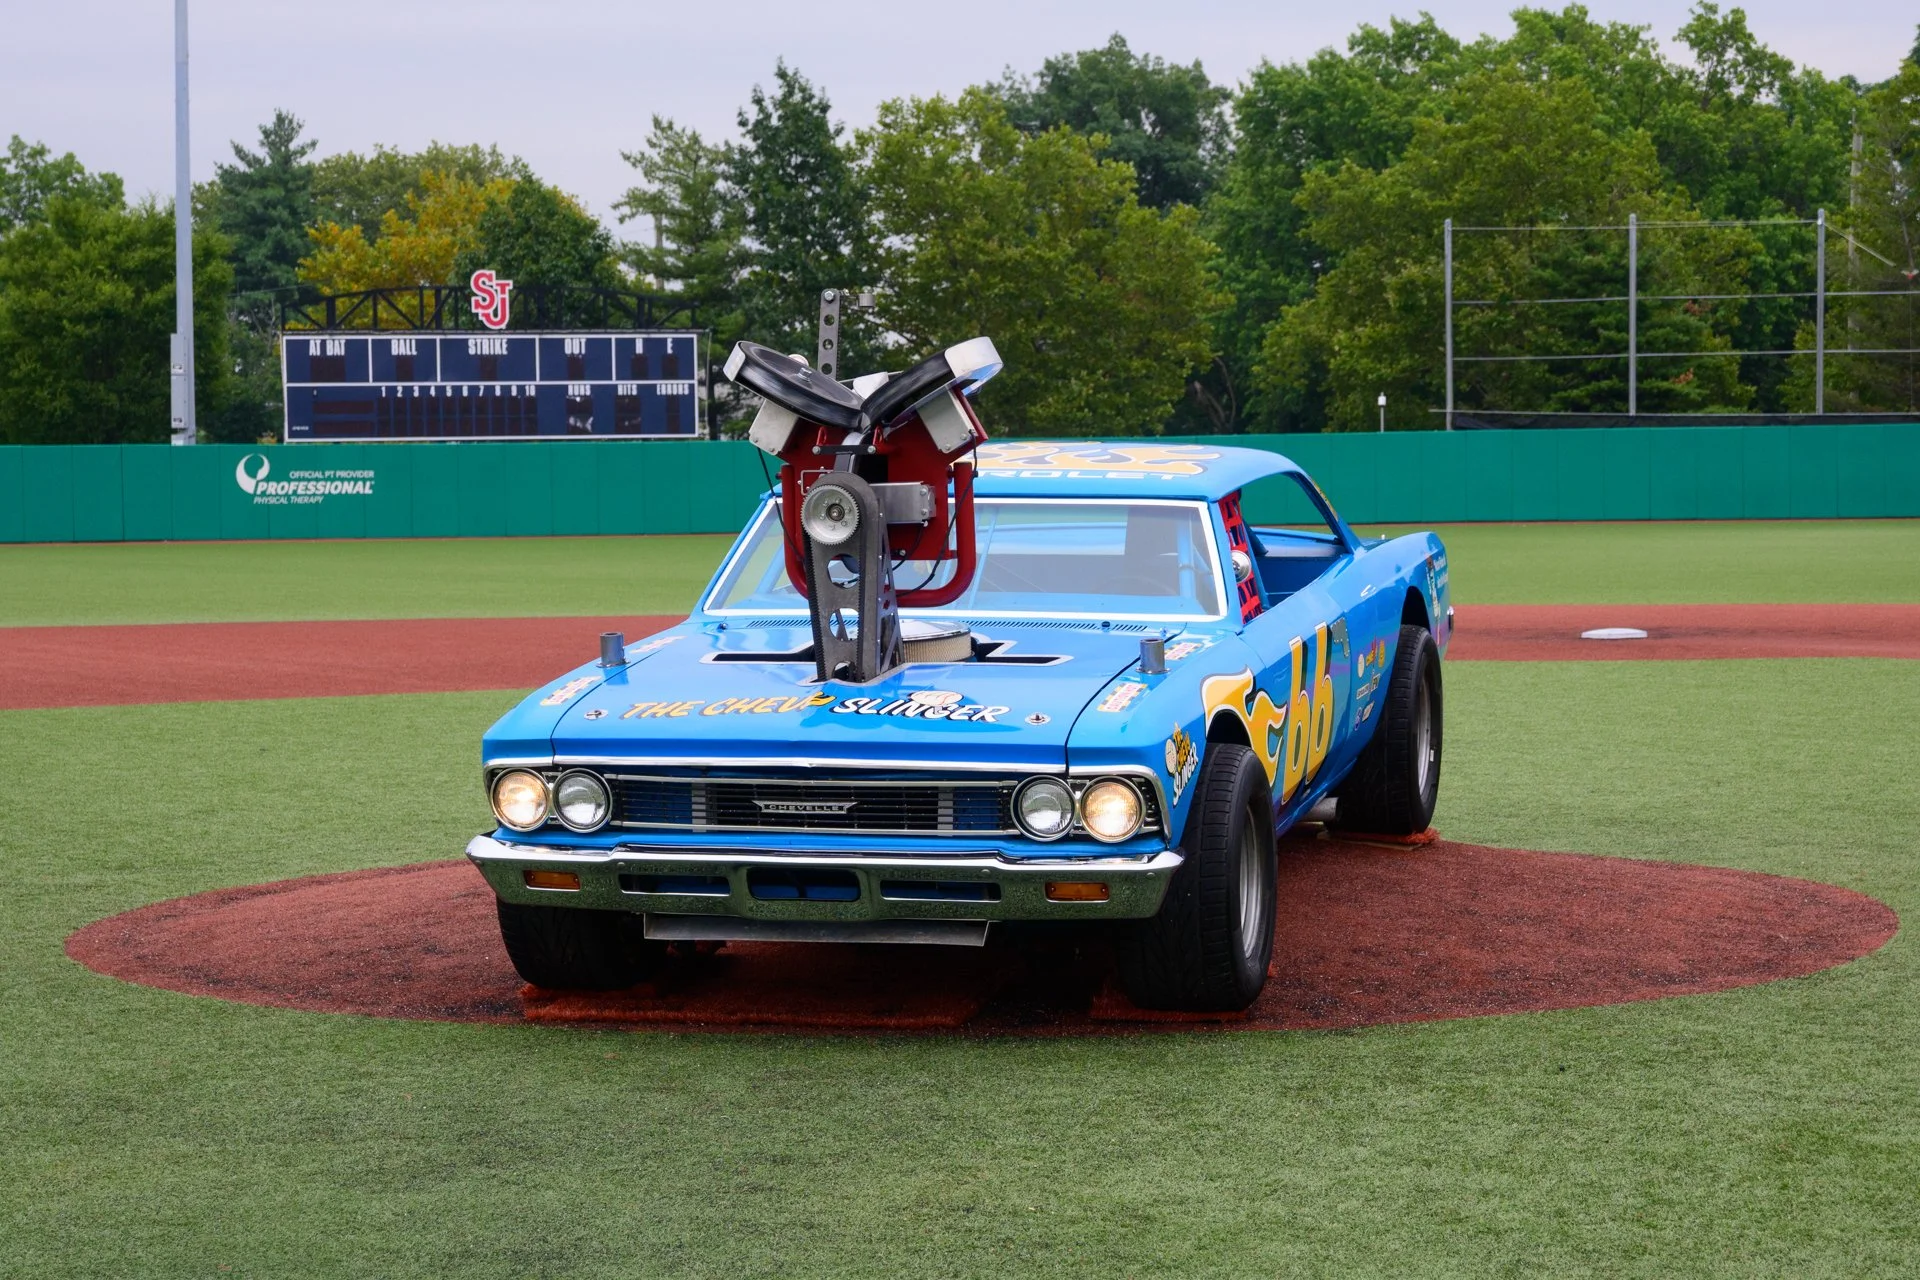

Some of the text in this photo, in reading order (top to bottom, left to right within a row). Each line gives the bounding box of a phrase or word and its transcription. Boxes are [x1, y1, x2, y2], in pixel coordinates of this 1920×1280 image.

[309, 339, 346, 356] AT BAT
[391, 339, 417, 356] BALL
[468, 338, 508, 355] STRIKE
[564, 338, 586, 354] OUT
[667, 338, 673, 354] E
[381, 384, 535, 397] 1 2 3 4 5 6 7 8 9 10
[568, 384, 591, 396] RUNS
[618, 384, 637, 396] HITS
[656, 383, 689, 395] ERRORS
[289, 470, 374, 479] OFFICIAL PT PROVIDER
[978, 470, 1190, 480] ROLET
[256, 481, 373, 495] PROFESSIONAL
[254, 495, 324, 504] PHYSICAL THERAPY
[620, 691, 1010, 723] THE CHEVY SLINGER
[769, 804, 840, 812] CHEVELLE
